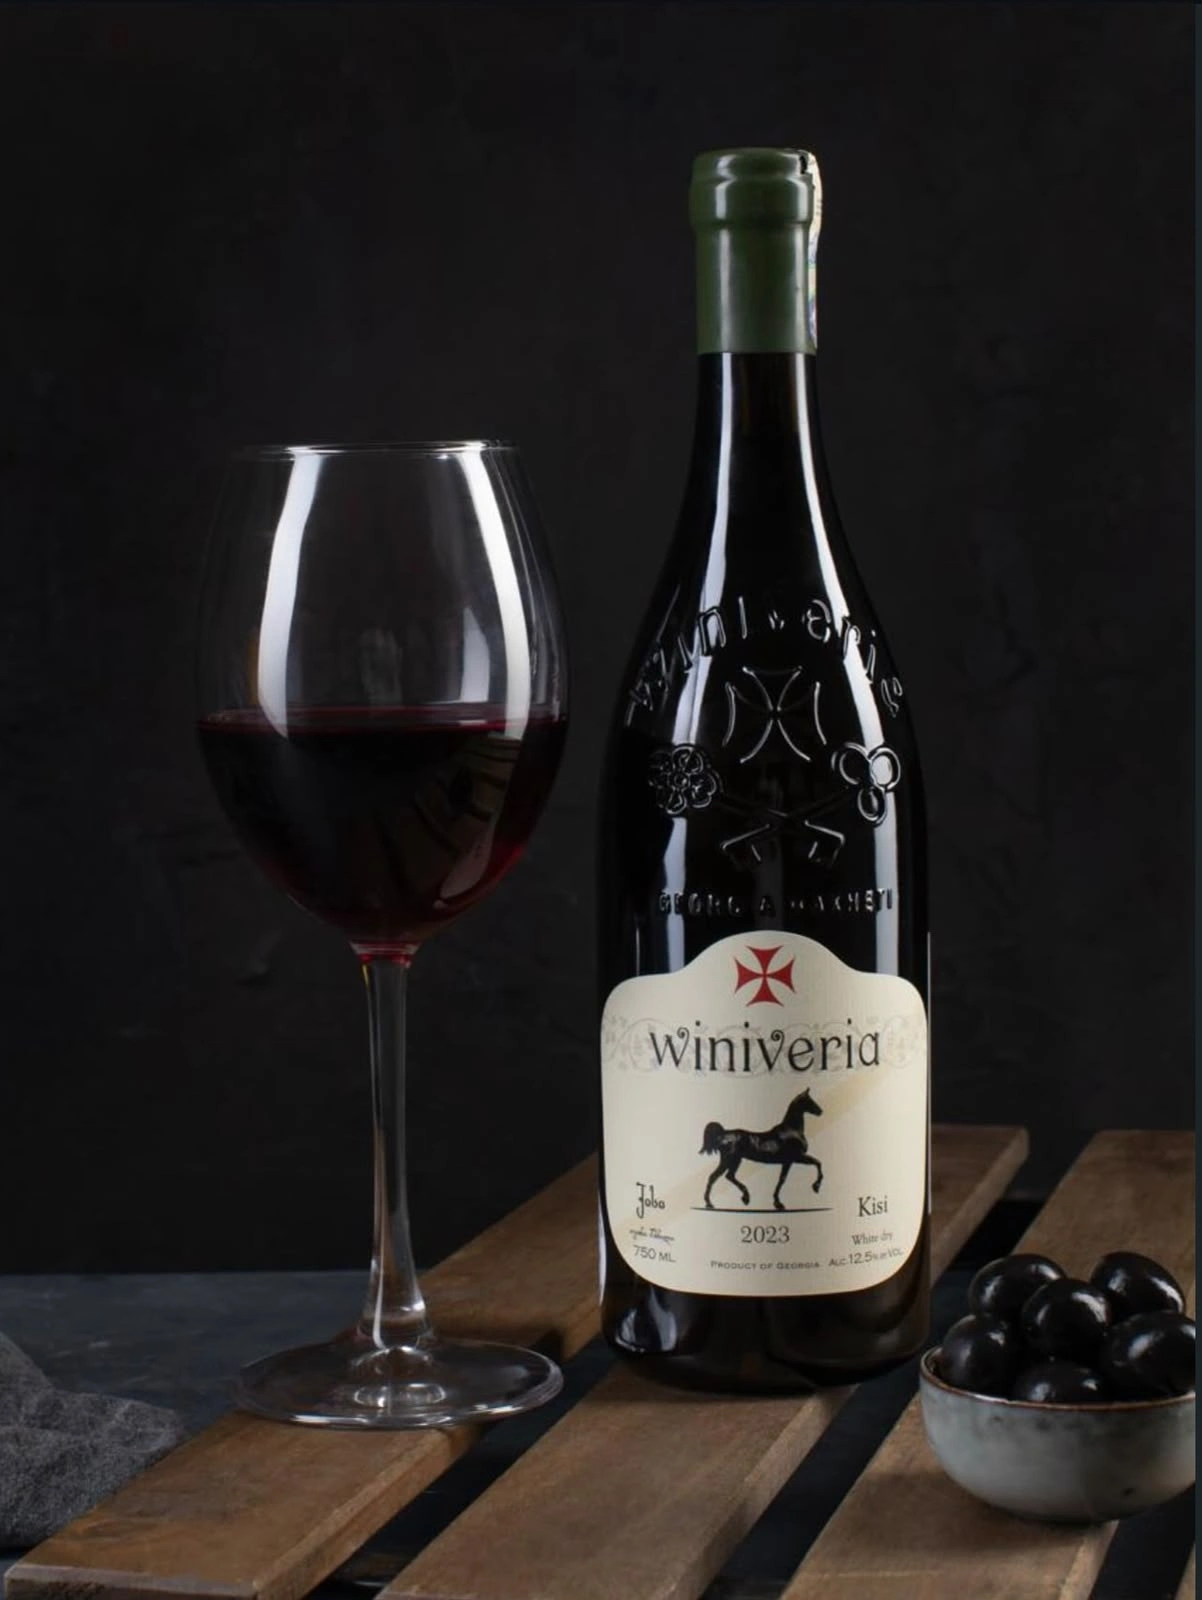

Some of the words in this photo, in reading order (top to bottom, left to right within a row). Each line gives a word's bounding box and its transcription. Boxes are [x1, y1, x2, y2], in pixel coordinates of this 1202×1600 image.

[650, 1018, 880, 1072] winiveria
[858, 1195, 888, 1217] Kisi
[740, 1225, 790, 1243] 2023
[851, 1233, 879, 1246] White
[633, 1244, 657, 1260] 750
[658, 1251, 677, 1263] ML
